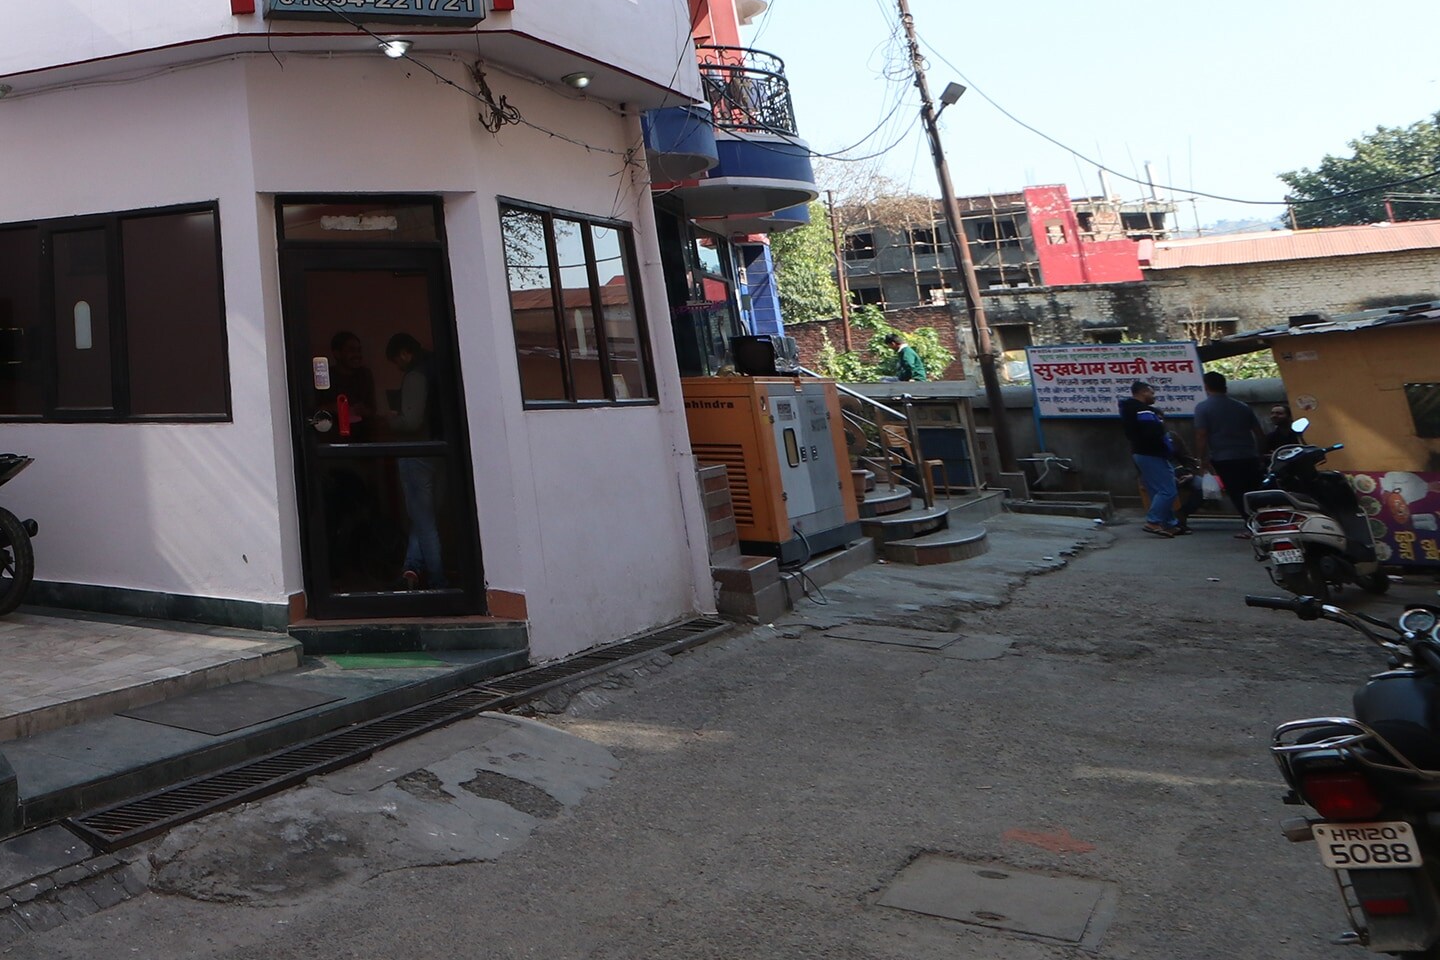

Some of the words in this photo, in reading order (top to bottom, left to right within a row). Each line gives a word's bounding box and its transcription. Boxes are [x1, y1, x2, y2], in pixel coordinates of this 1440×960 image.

[1033, 361, 1106, 380] सुखधाम
[1108, 357, 1148, 375] यात्री
[1151, 359, 1195, 374] भवन
[685, 399, 734, 410] ahindra
[1329, 843, 1413, 865] 5088
